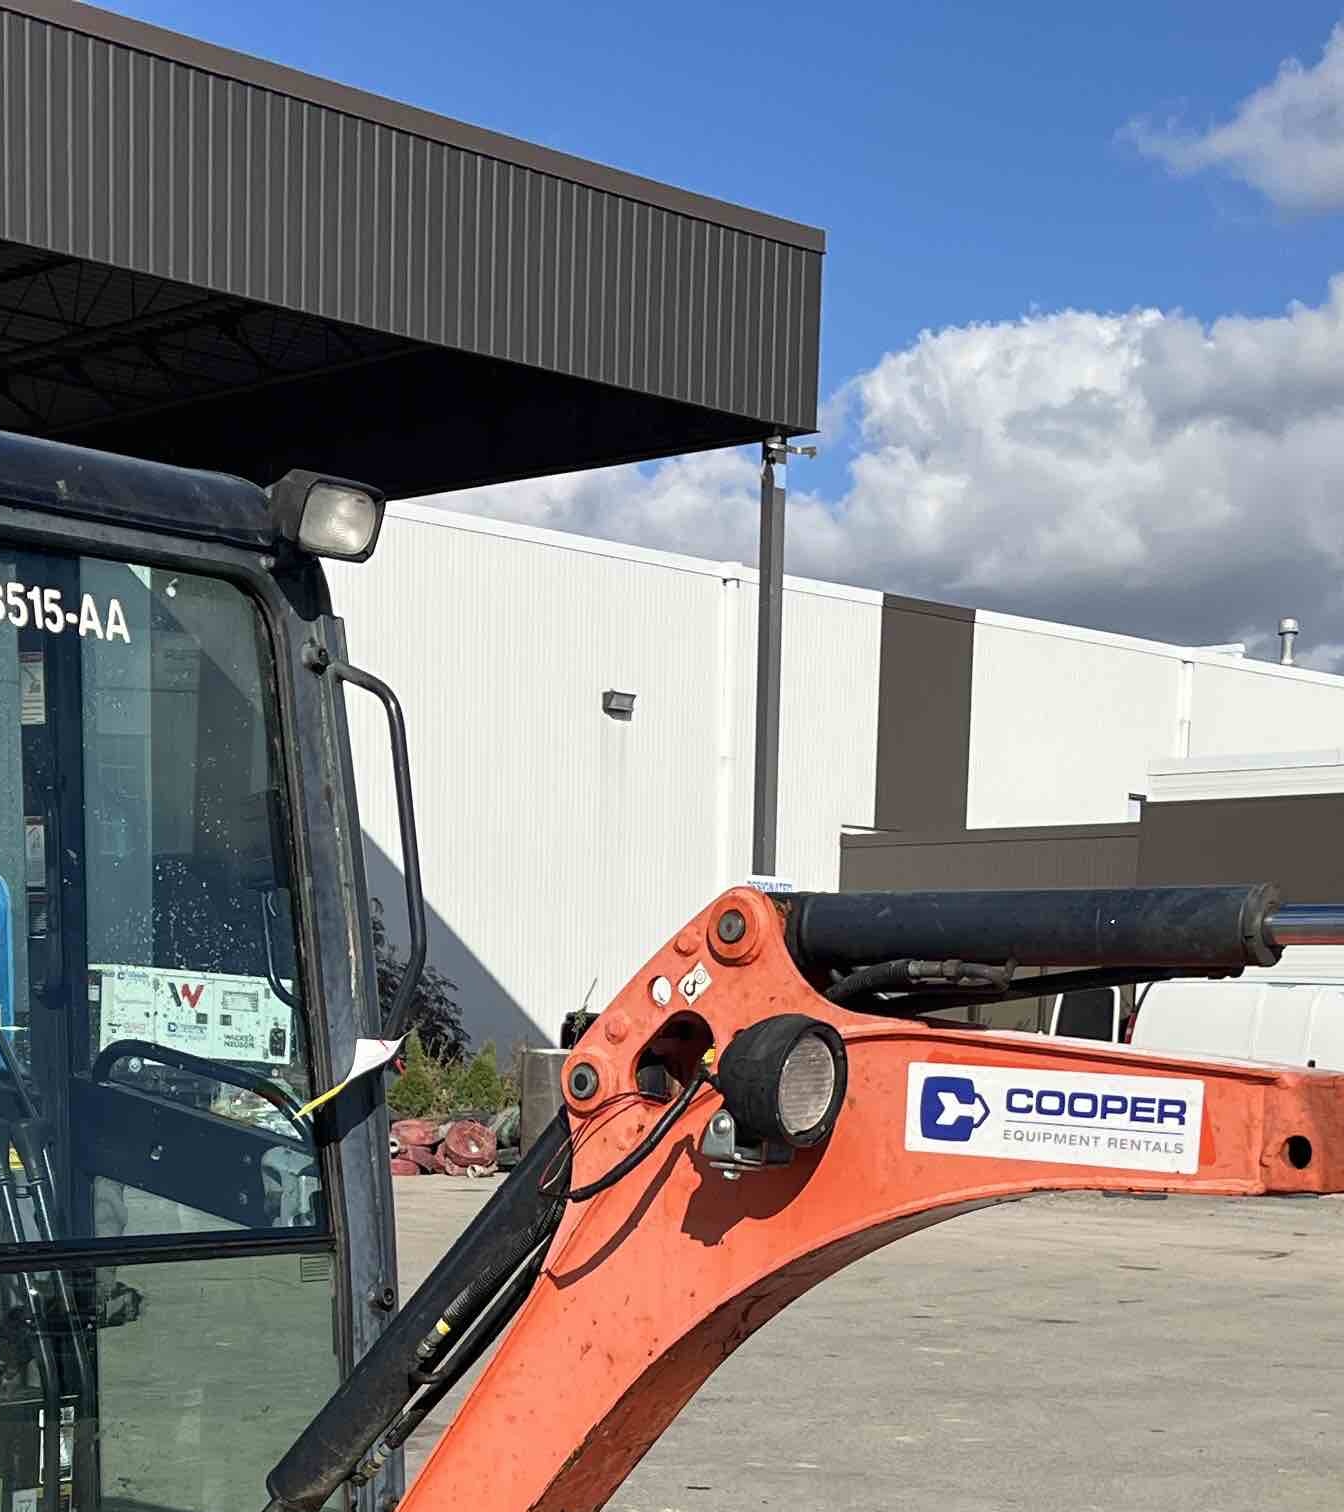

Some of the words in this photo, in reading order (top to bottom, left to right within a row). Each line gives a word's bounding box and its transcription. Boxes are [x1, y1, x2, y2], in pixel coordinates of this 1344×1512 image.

[1005, 1088, 1187, 1126] COOPER
[1002, 1129, 1101, 1148] EQUIPMENT
[1107, 1137, 1185, 1155] RENTALS
